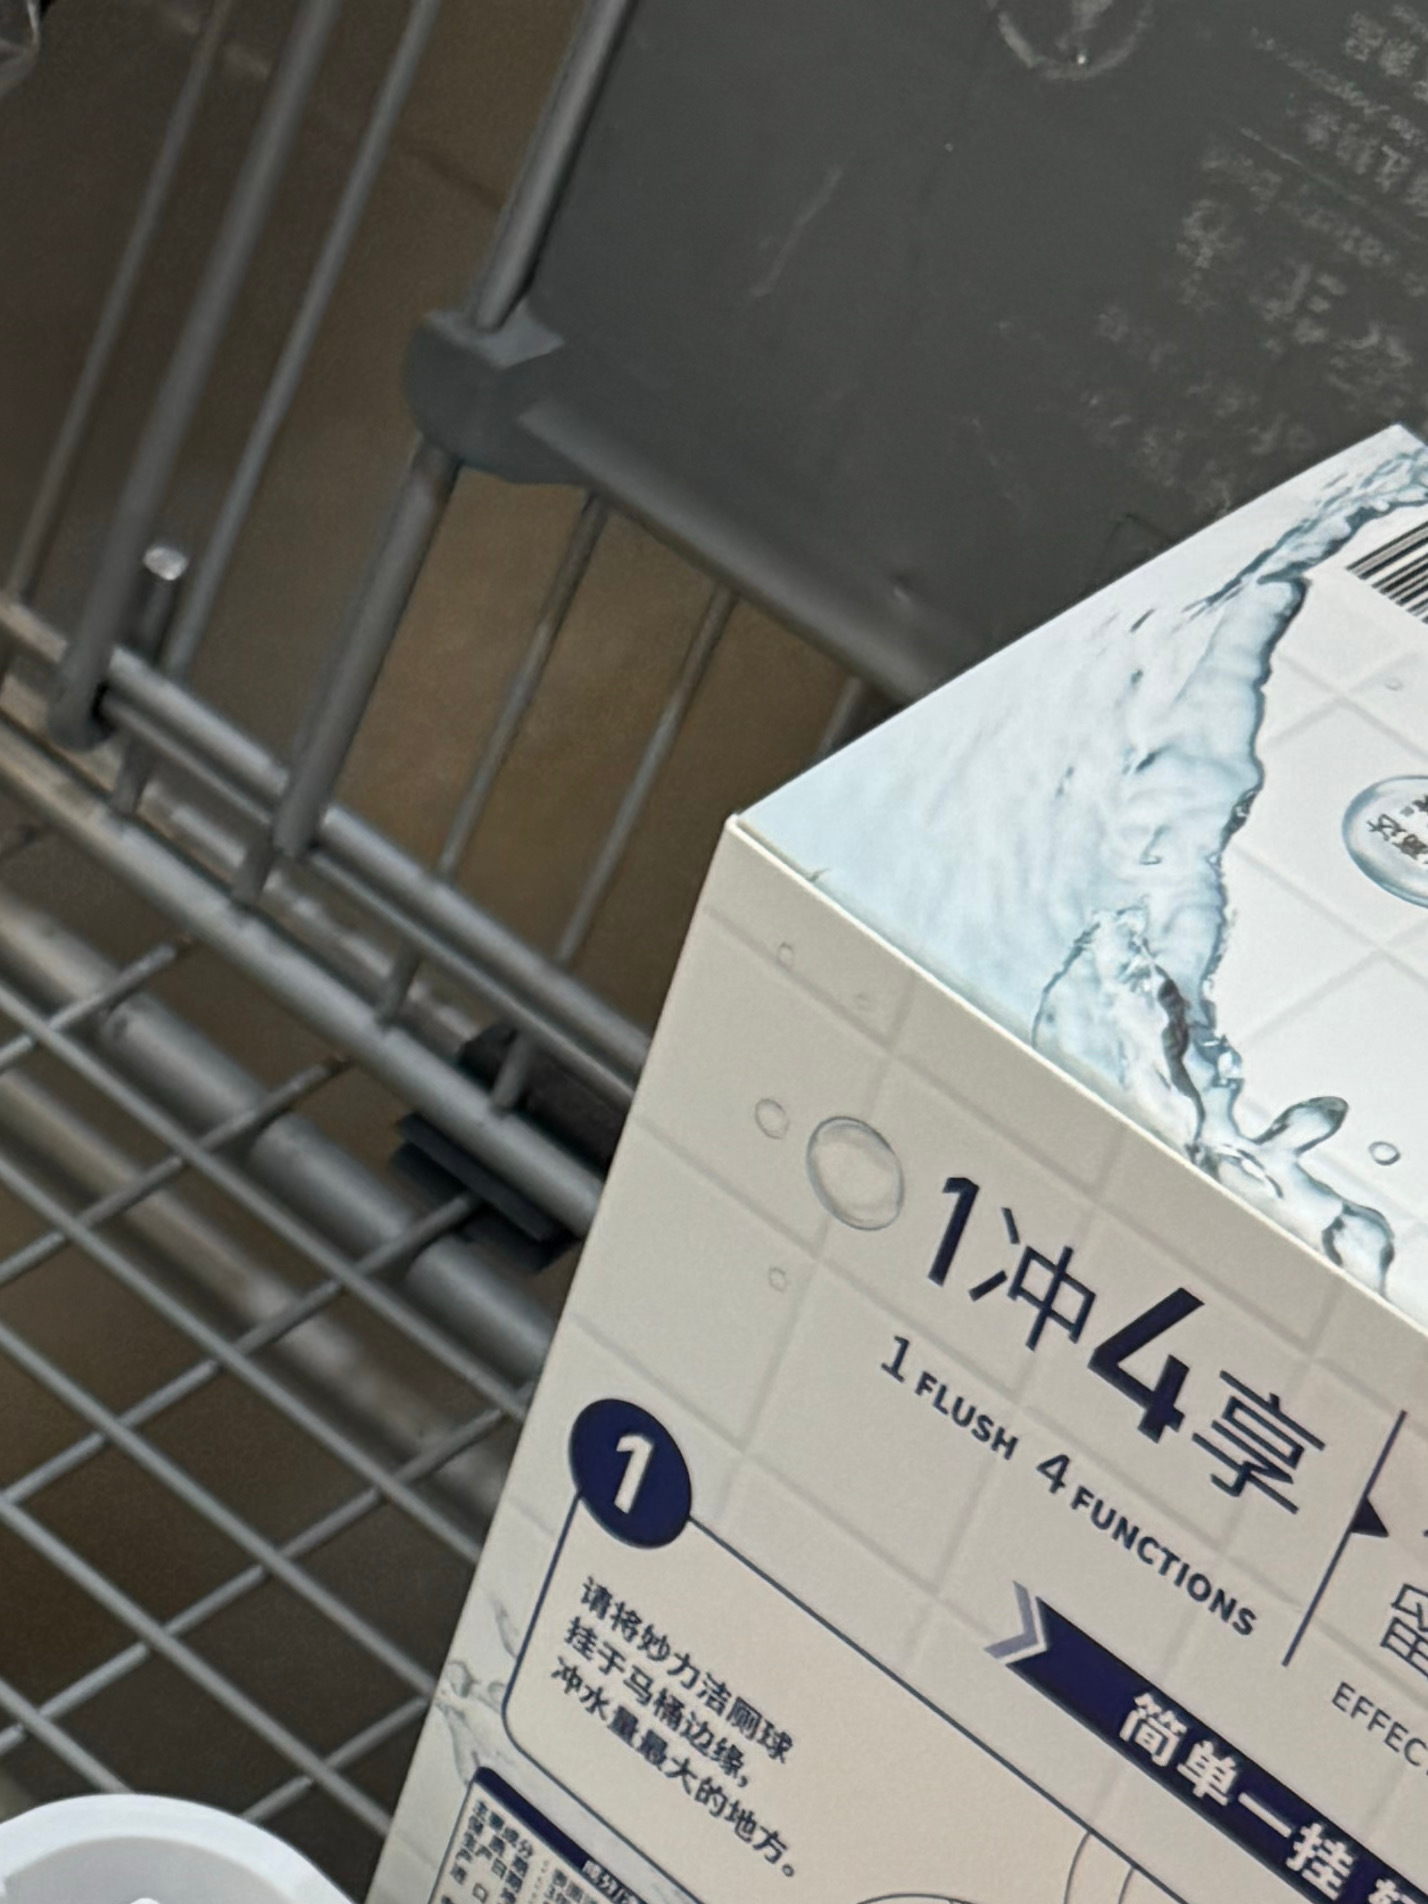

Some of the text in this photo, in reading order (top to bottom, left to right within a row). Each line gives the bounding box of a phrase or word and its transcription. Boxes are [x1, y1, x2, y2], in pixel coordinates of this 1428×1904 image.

[927, 1175, 1326, 1515] 1冲4享
[603, 1431, 653, 1516] 1
[880, 1334, 1257, 1636] 1 FLUSH 4 FUNCTIONS
[549, 1655, 795, 1878] 冲水量最大的地方。
[579, 1575, 794, 1764] 请将妙力洁厕球
[1332, 1681, 1428, 1776] EFFEC
[1119, 1693, 1355, 1901] 简单一挂
